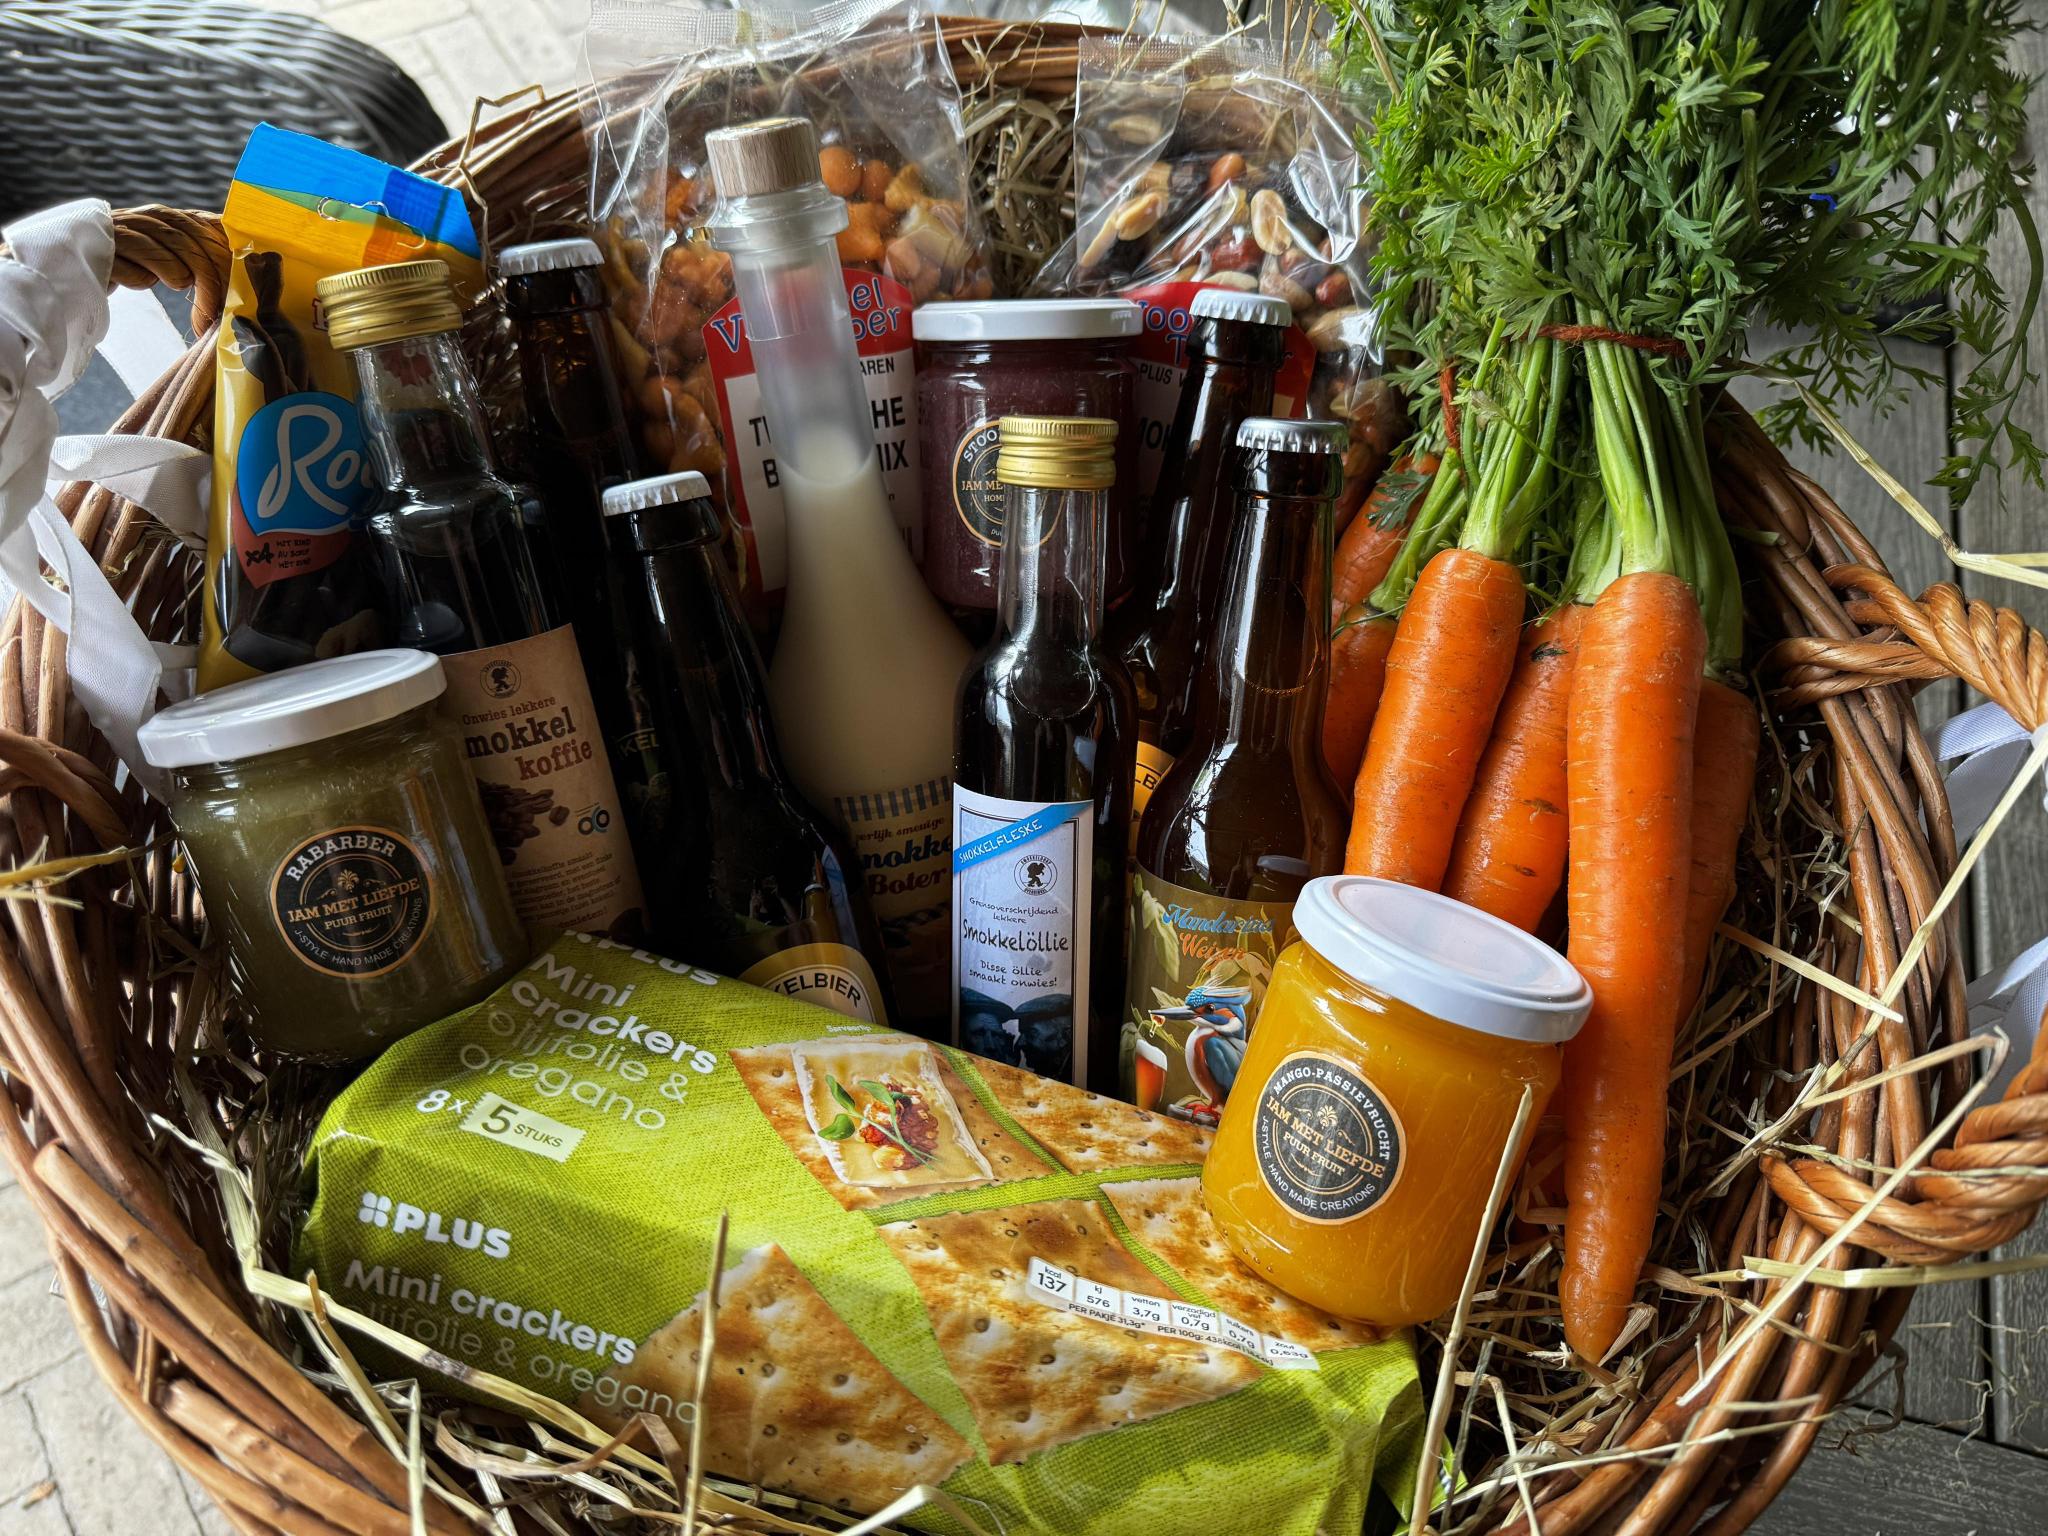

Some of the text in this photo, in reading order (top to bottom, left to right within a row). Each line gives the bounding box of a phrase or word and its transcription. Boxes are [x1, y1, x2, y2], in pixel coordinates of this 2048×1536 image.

[1139, 363, 1173, 384] PLUS
[961, 480, 982, 491] JAM
[462, 696, 557, 726] Onwies lekkere
[515, 738, 593, 782] koffie
[286, 835, 397, 881] RABARBER
[868, 867, 947, 896] Boter
[288, 877, 420, 923] JAM MET LIEFDE
[294, 897, 423, 967] J-STYLE HAND MADE CREATIONS
[324, 905, 393, 930] PUUR FRUIT
[962, 918, 1069, 952] Smokkelöllie
[529, 953, 637, 1007] Mini
[969, 968, 1058, 988] smaakt onwies!
[980, 959, 1044, 976] Disse öllie
[659, 1072, 689, 1105] &
[481, 1103, 519, 1135] 5
[513, 1123, 563, 1148] STUKS
[1273, 1067, 1391, 1161] MANGO-PASSIEVRUCHT
[1266, 1096, 1386, 1179] JAM MET LIEFDE
[1262, 1115, 1376, 1211] J-STYLE HAND MADE CREATIONS
[1283, 1131, 1346, 1177] PUUR FRUIT
[393, 1201, 512, 1259] PLUS
[1038, 1272, 1067, 1292] 137
[1044, 1266, 1061, 1279] kcal
[344, 1259, 637, 1365] Mini crackers
[1086, 1295, 1110, 1308] 576
[1133, 1307, 1160, 1322] 3,7g
[1172, 1303, 1216, 1318] verzadigd
[1068, 1303, 1087, 1314] PER
[1157, 1325, 1176, 1335] PER
[1181, 1316, 1210, 1331] 0,7g
[1228, 1330, 1256, 1349] 0,7g
[343, 1301, 699, 1424] lijfolie & oregano
